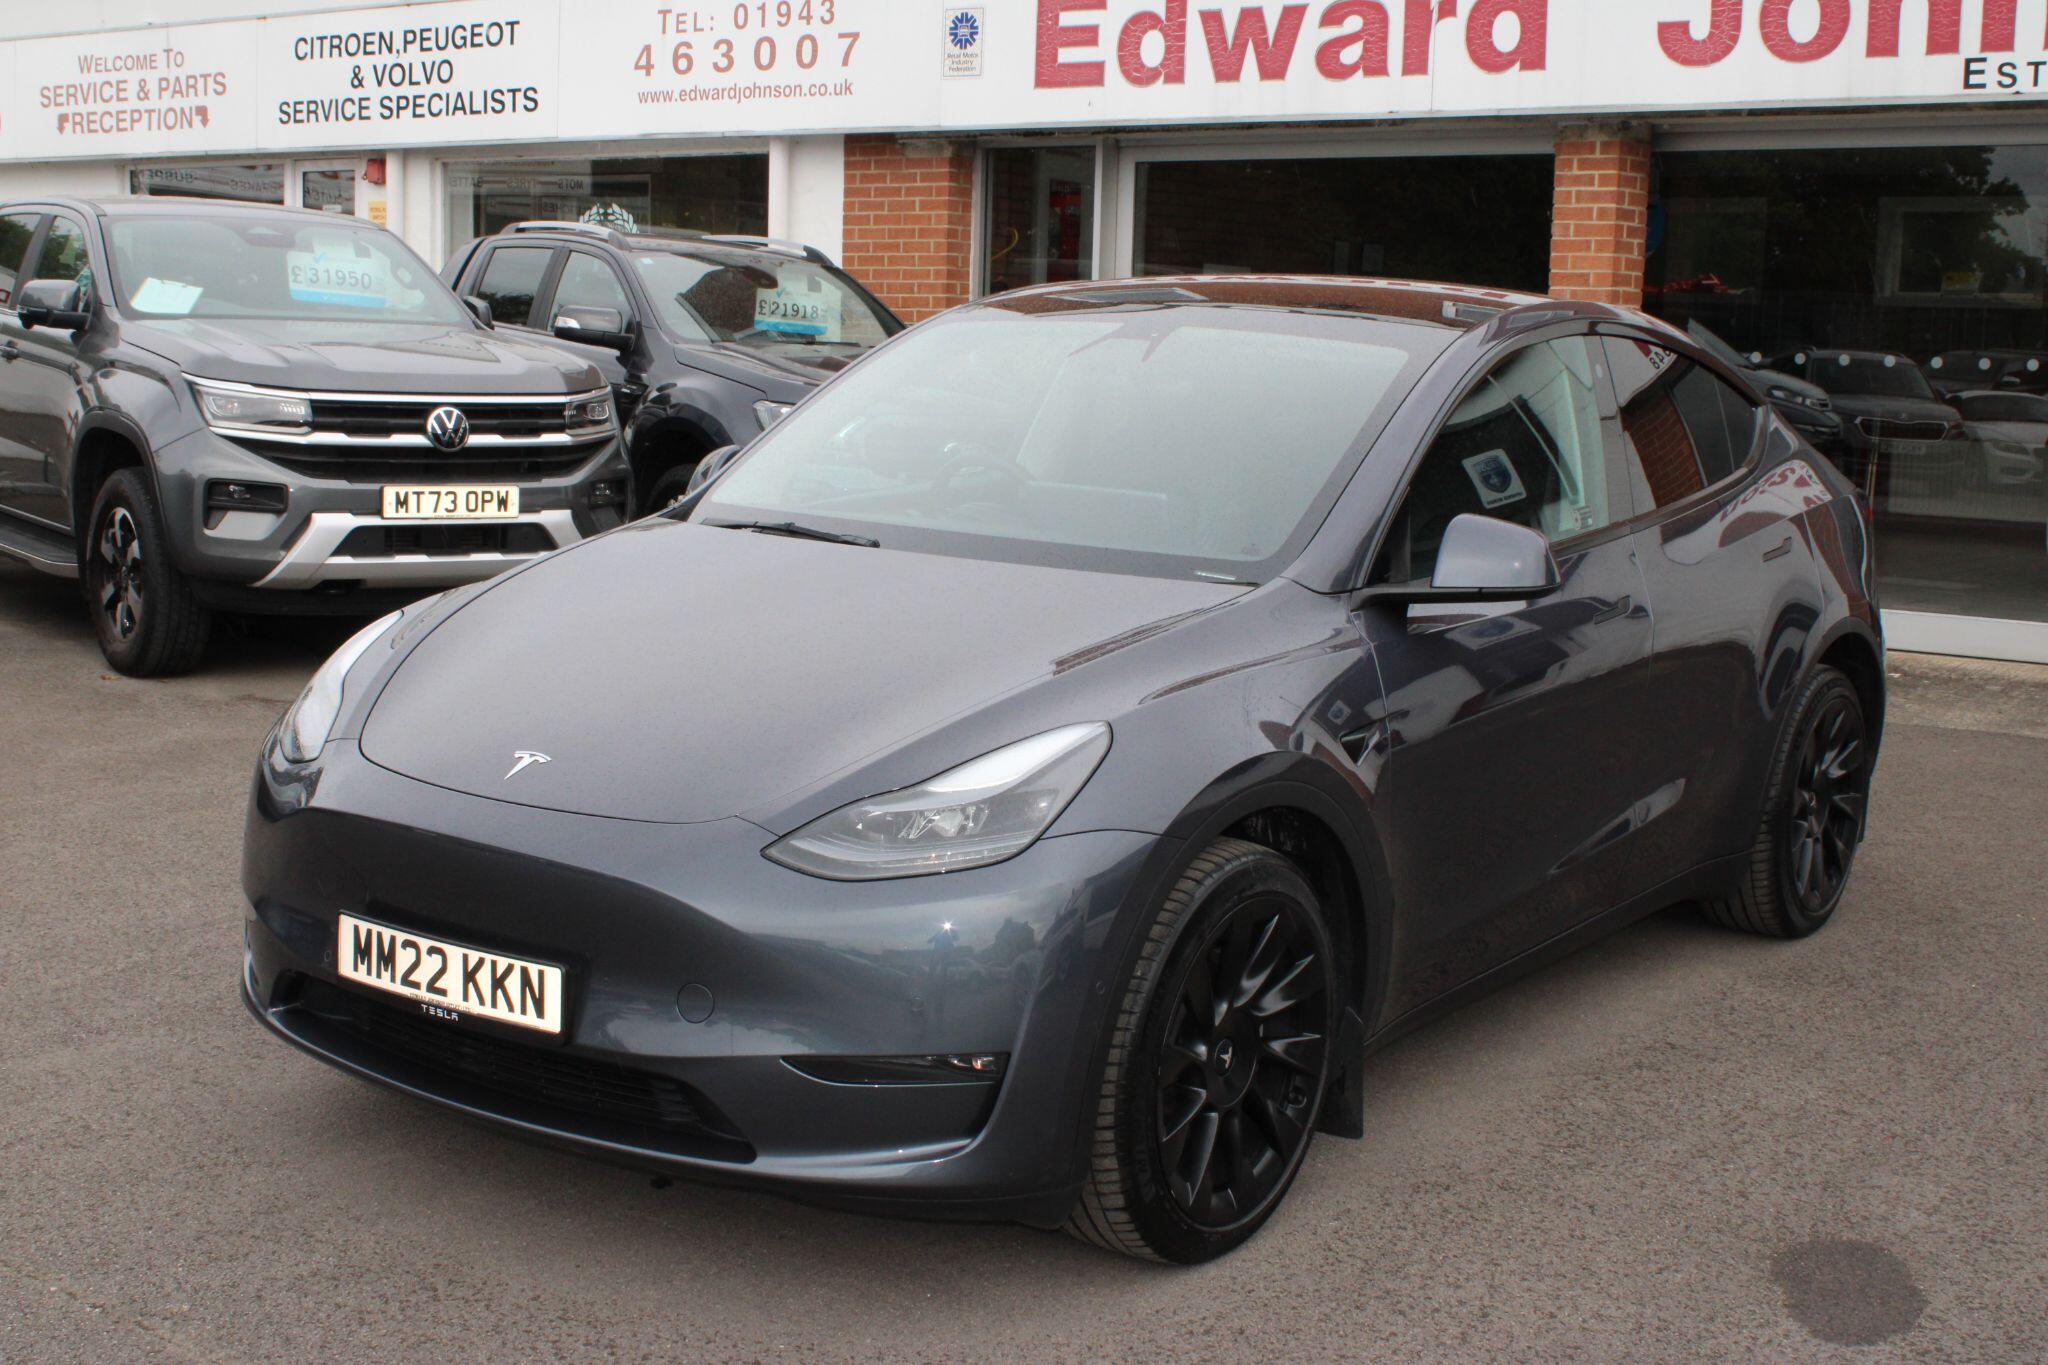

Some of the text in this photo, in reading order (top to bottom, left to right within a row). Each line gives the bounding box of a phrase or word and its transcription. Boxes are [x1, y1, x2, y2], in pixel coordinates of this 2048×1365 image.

[733, 0, 836, 30] 01943
[633, 31, 861, 77] 463007
[1034, 0, 1547, 89] Edward
[350, 59, 454, 89] & VOLVO
[1963, 57, 2047, 90] EST
[40, 72, 228, 108] SERVICE & PARTS
[637, 79, 854, 104] www.edwardjohnson.co.uk
[278, 86, 539, 125] SERVICE SPECIALISTS
[71, 107, 195, 135] RECEPTION
[291, 265, 372, 289] £31950
[758, 300, 819, 319] £21918
[395, 490, 509, 513] MT73 OPW
[353, 924, 546, 1020] MM22 KKN
[421, 1004, 459, 1022] TESLA
